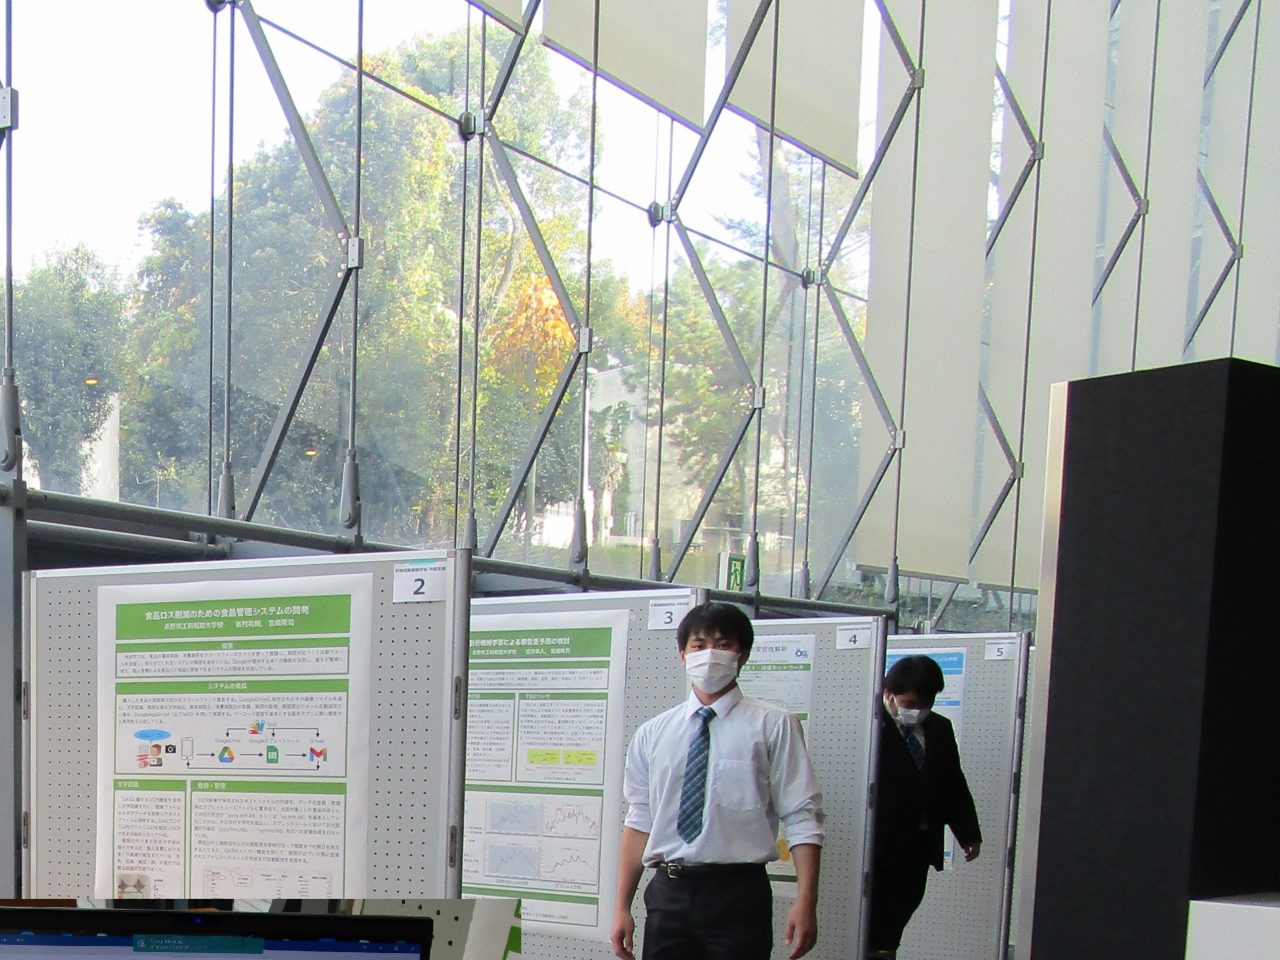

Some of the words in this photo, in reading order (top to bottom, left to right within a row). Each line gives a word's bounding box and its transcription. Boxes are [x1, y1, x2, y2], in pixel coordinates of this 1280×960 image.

[413, 578, 425, 595] 2
[145, 605, 310, 621] 食品ロス削減のための食品管理システムの開発
[664, 611, 673, 625] 3
[848, 634, 858, 645] 4
[996, 647, 1004, 657] 5
